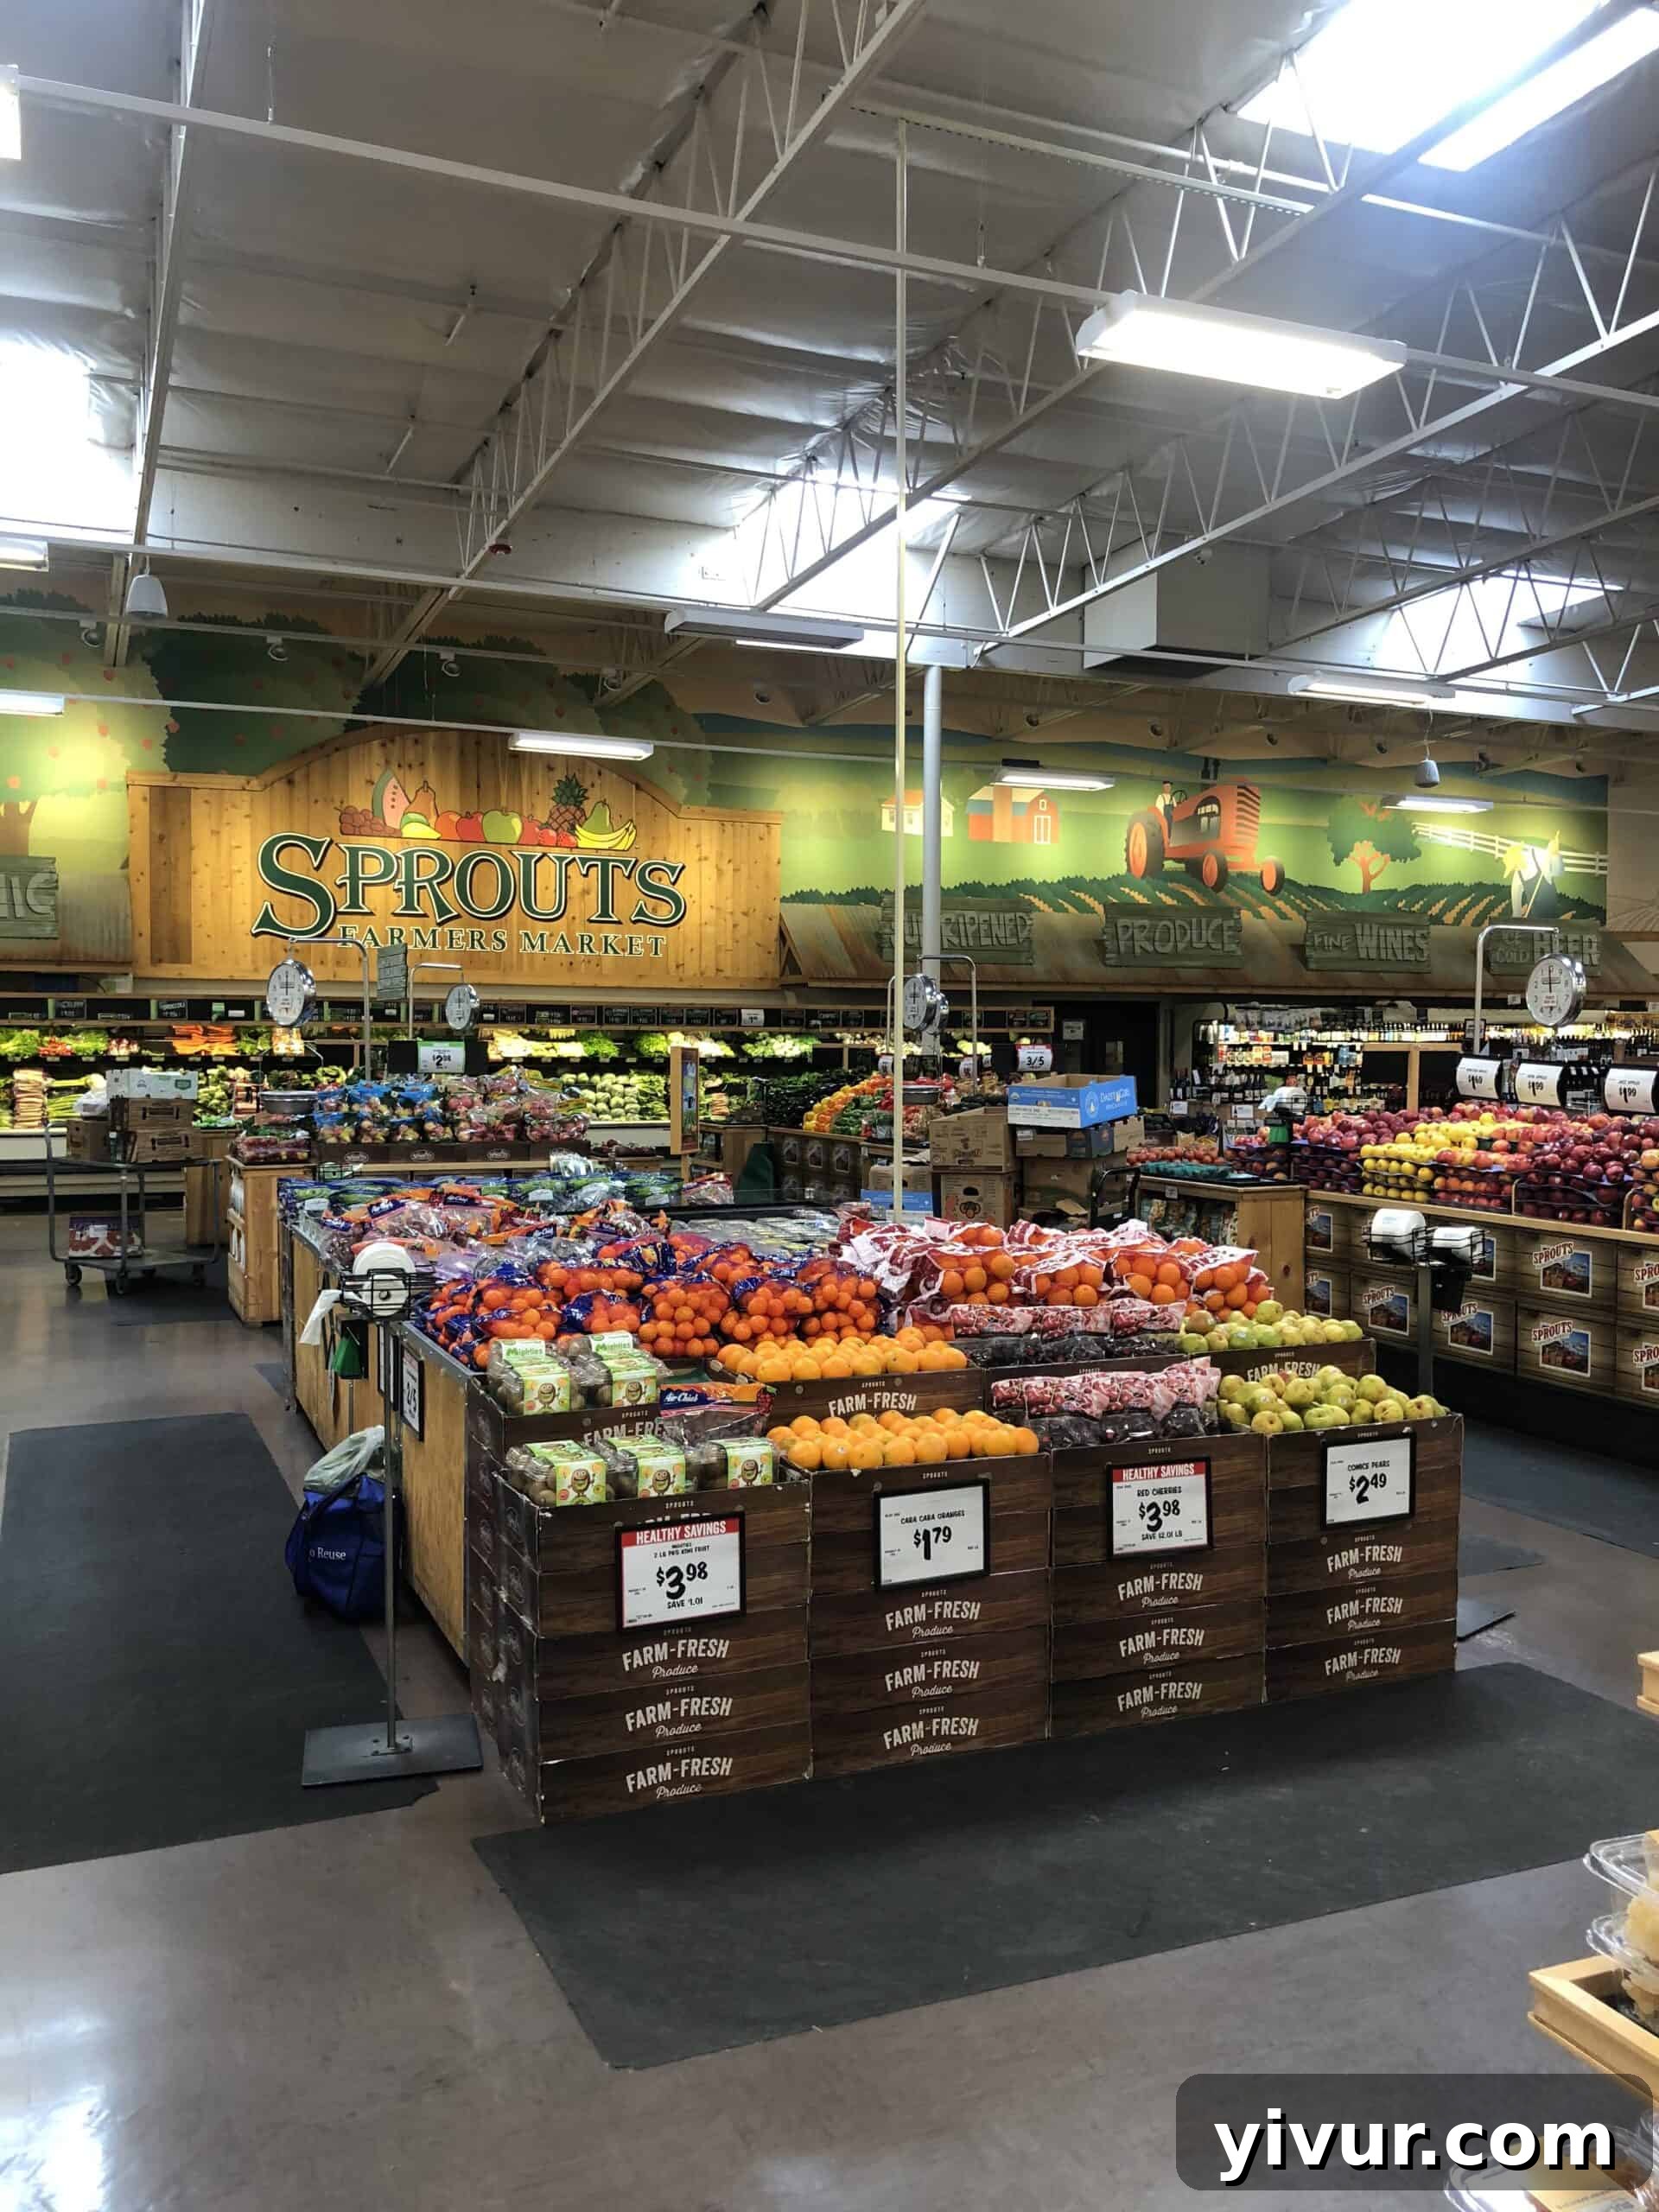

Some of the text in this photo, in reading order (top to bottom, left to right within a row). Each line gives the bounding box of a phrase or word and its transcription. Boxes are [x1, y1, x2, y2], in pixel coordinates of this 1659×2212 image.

[251, 832, 688, 938] SPROUTS
[340, 925, 666, 957] FARMERS MARKET
[1116, 918, 1241, 954] PRODUCE
[1313, 923, 1427, 961] FINE WINES
[1027, 1056, 1045, 1066] 3/5
[1533, 1242, 1575, 1264] SPROUTS
[1362, 1286, 1395, 1303] SPROUTS
[1531, 1321, 1573, 1342] SPROUTS
[828, 1392, 918, 1417] FARM-FRESH
[1123, 1463, 1195, 1481] HEALTHY SAVINGS
[1152, 1485, 1182, 1496] CHERRIES
[1349, 1473, 1387, 1504] $249
[900, 1516, 917, 1524] CARA
[938, 1510, 964, 1520] ORANGES
[1139, 1499, 1180, 1533] $398
[636, 1521, 727, 1545] HEALTHY SAVINGS
[913, 1526, 952, 1560] $179
[317, 1547, 346, 1560] Reuse
[1326, 1545, 1402, 1573] FARM-FRESH
[656, 1561, 708, 1600] $398
[1348, 1567, 1381, 1580] Produce
[1117, 1573, 1203, 1601] FARM-FRESH
[667, 1600, 684, 1609] SAVE
[1141, 1597, 1179, 1608] Produce
[1326, 1597, 1403, 1624] FARM-FRESH
[885, 1601, 981, 1631] FARM-FRESH
[1347, 1619, 1381, 1631] Produce
[912, 1625, 954, 1638] Produce
[1119, 1628, 1205, 1657] FARM-FRESH
[622, 1638, 729, 1671] FARM-FRESH
[1143, 1651, 1180, 1664] Produce
[1325, 1647, 1401, 1675] FARM-FRESH
[652, 1664, 699, 1679] Produce
[885, 1660, 980, 1692] FARM-FRESH
[1345, 1670, 1378, 1681] Produce
[912, 1685, 953, 1698] Produce
[1117, 1682, 1202, 1712] FARM-FRESH
[626, 1697, 733, 1732] FARM-FRESH
[1141, 1705, 1178, 1718] Produce
[655, 1723, 702, 1738] Produce
[883, 1717, 979, 1750] FARM-FRESH
[910, 1742, 951, 1757] Produce
[626, 1757, 733, 1793] FARM-FRESH
[656, 1783, 703, 1798] Produce
